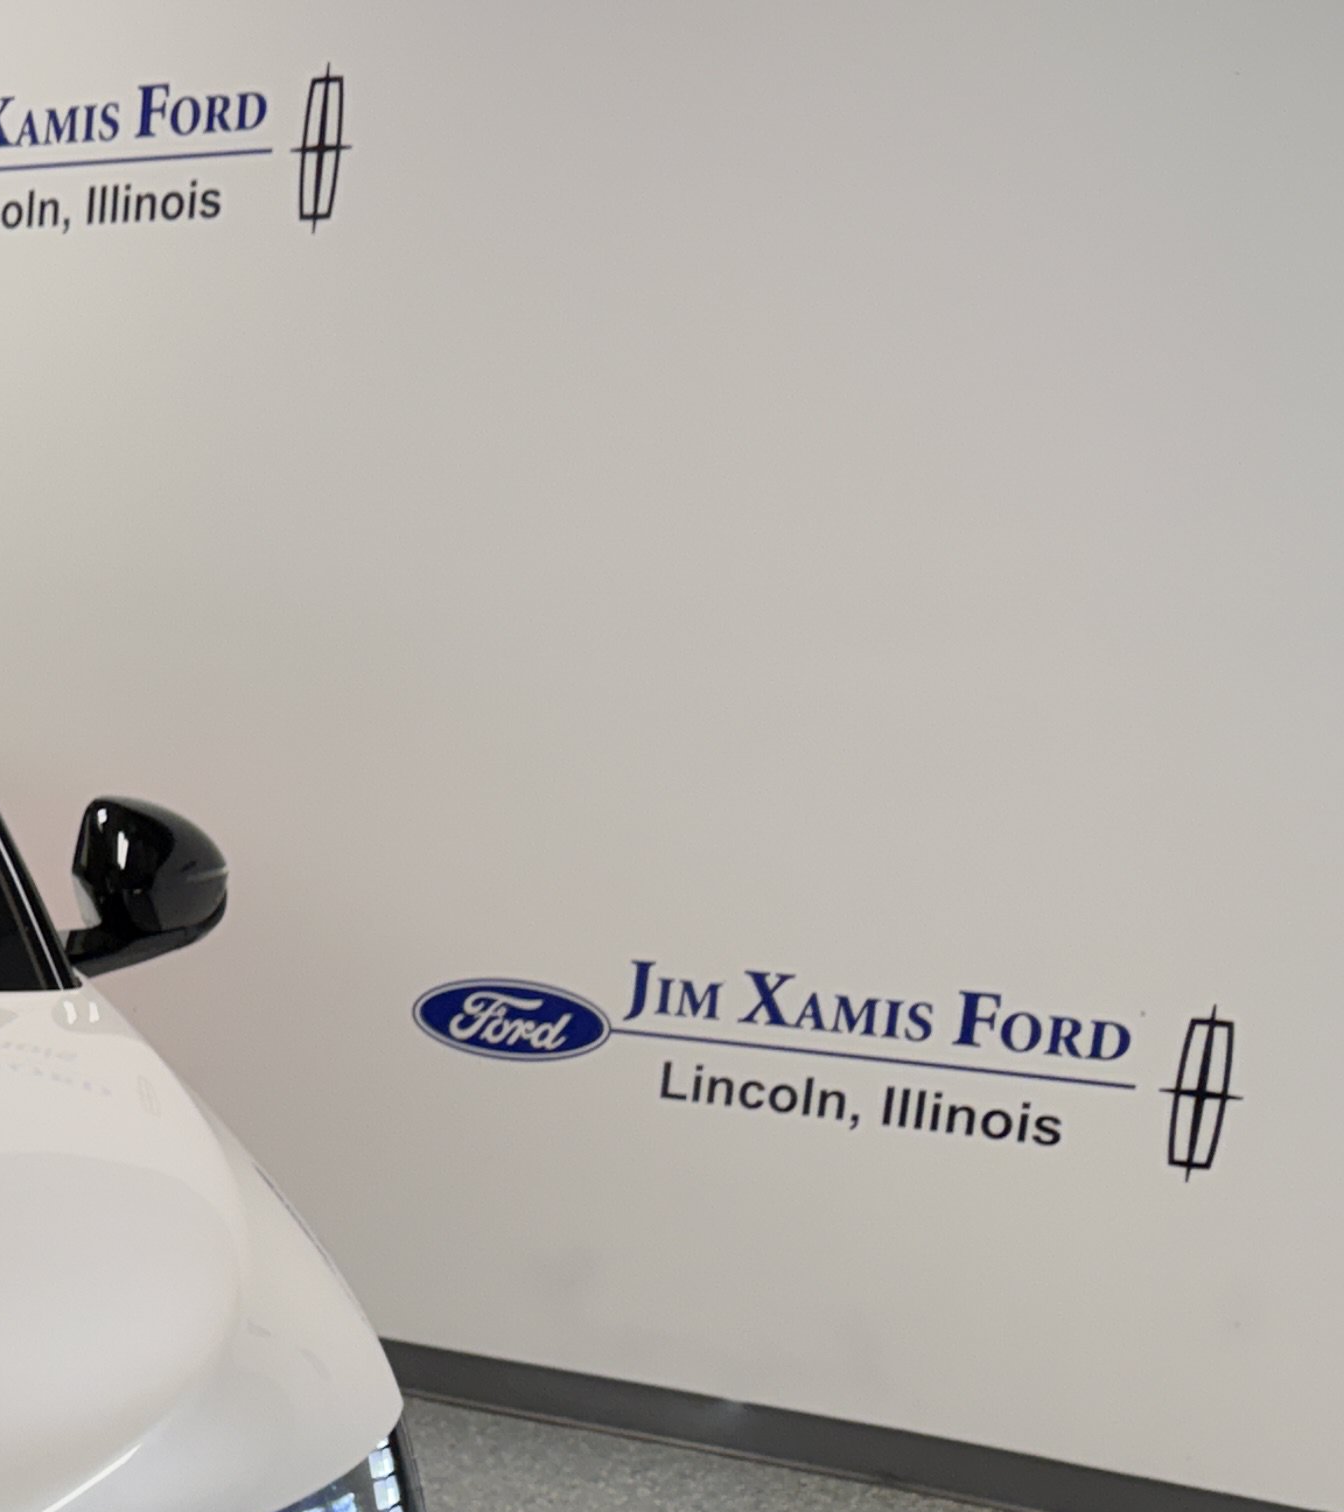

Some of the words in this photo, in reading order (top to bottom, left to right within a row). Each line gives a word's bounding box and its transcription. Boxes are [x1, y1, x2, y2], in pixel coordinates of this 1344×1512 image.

[134, 82, 268, 139] FORD
[86, 179, 222, 226] Illinois
[448, 990, 572, 1051] Ford
[622, 959, 723, 1022] JIM
[737, 970, 934, 1043] XAMIS
[950, 990, 1132, 1062] FORD
[659, 1060, 861, 1132] Lincoln,
[881, 1085, 1063, 1148] Illinois
